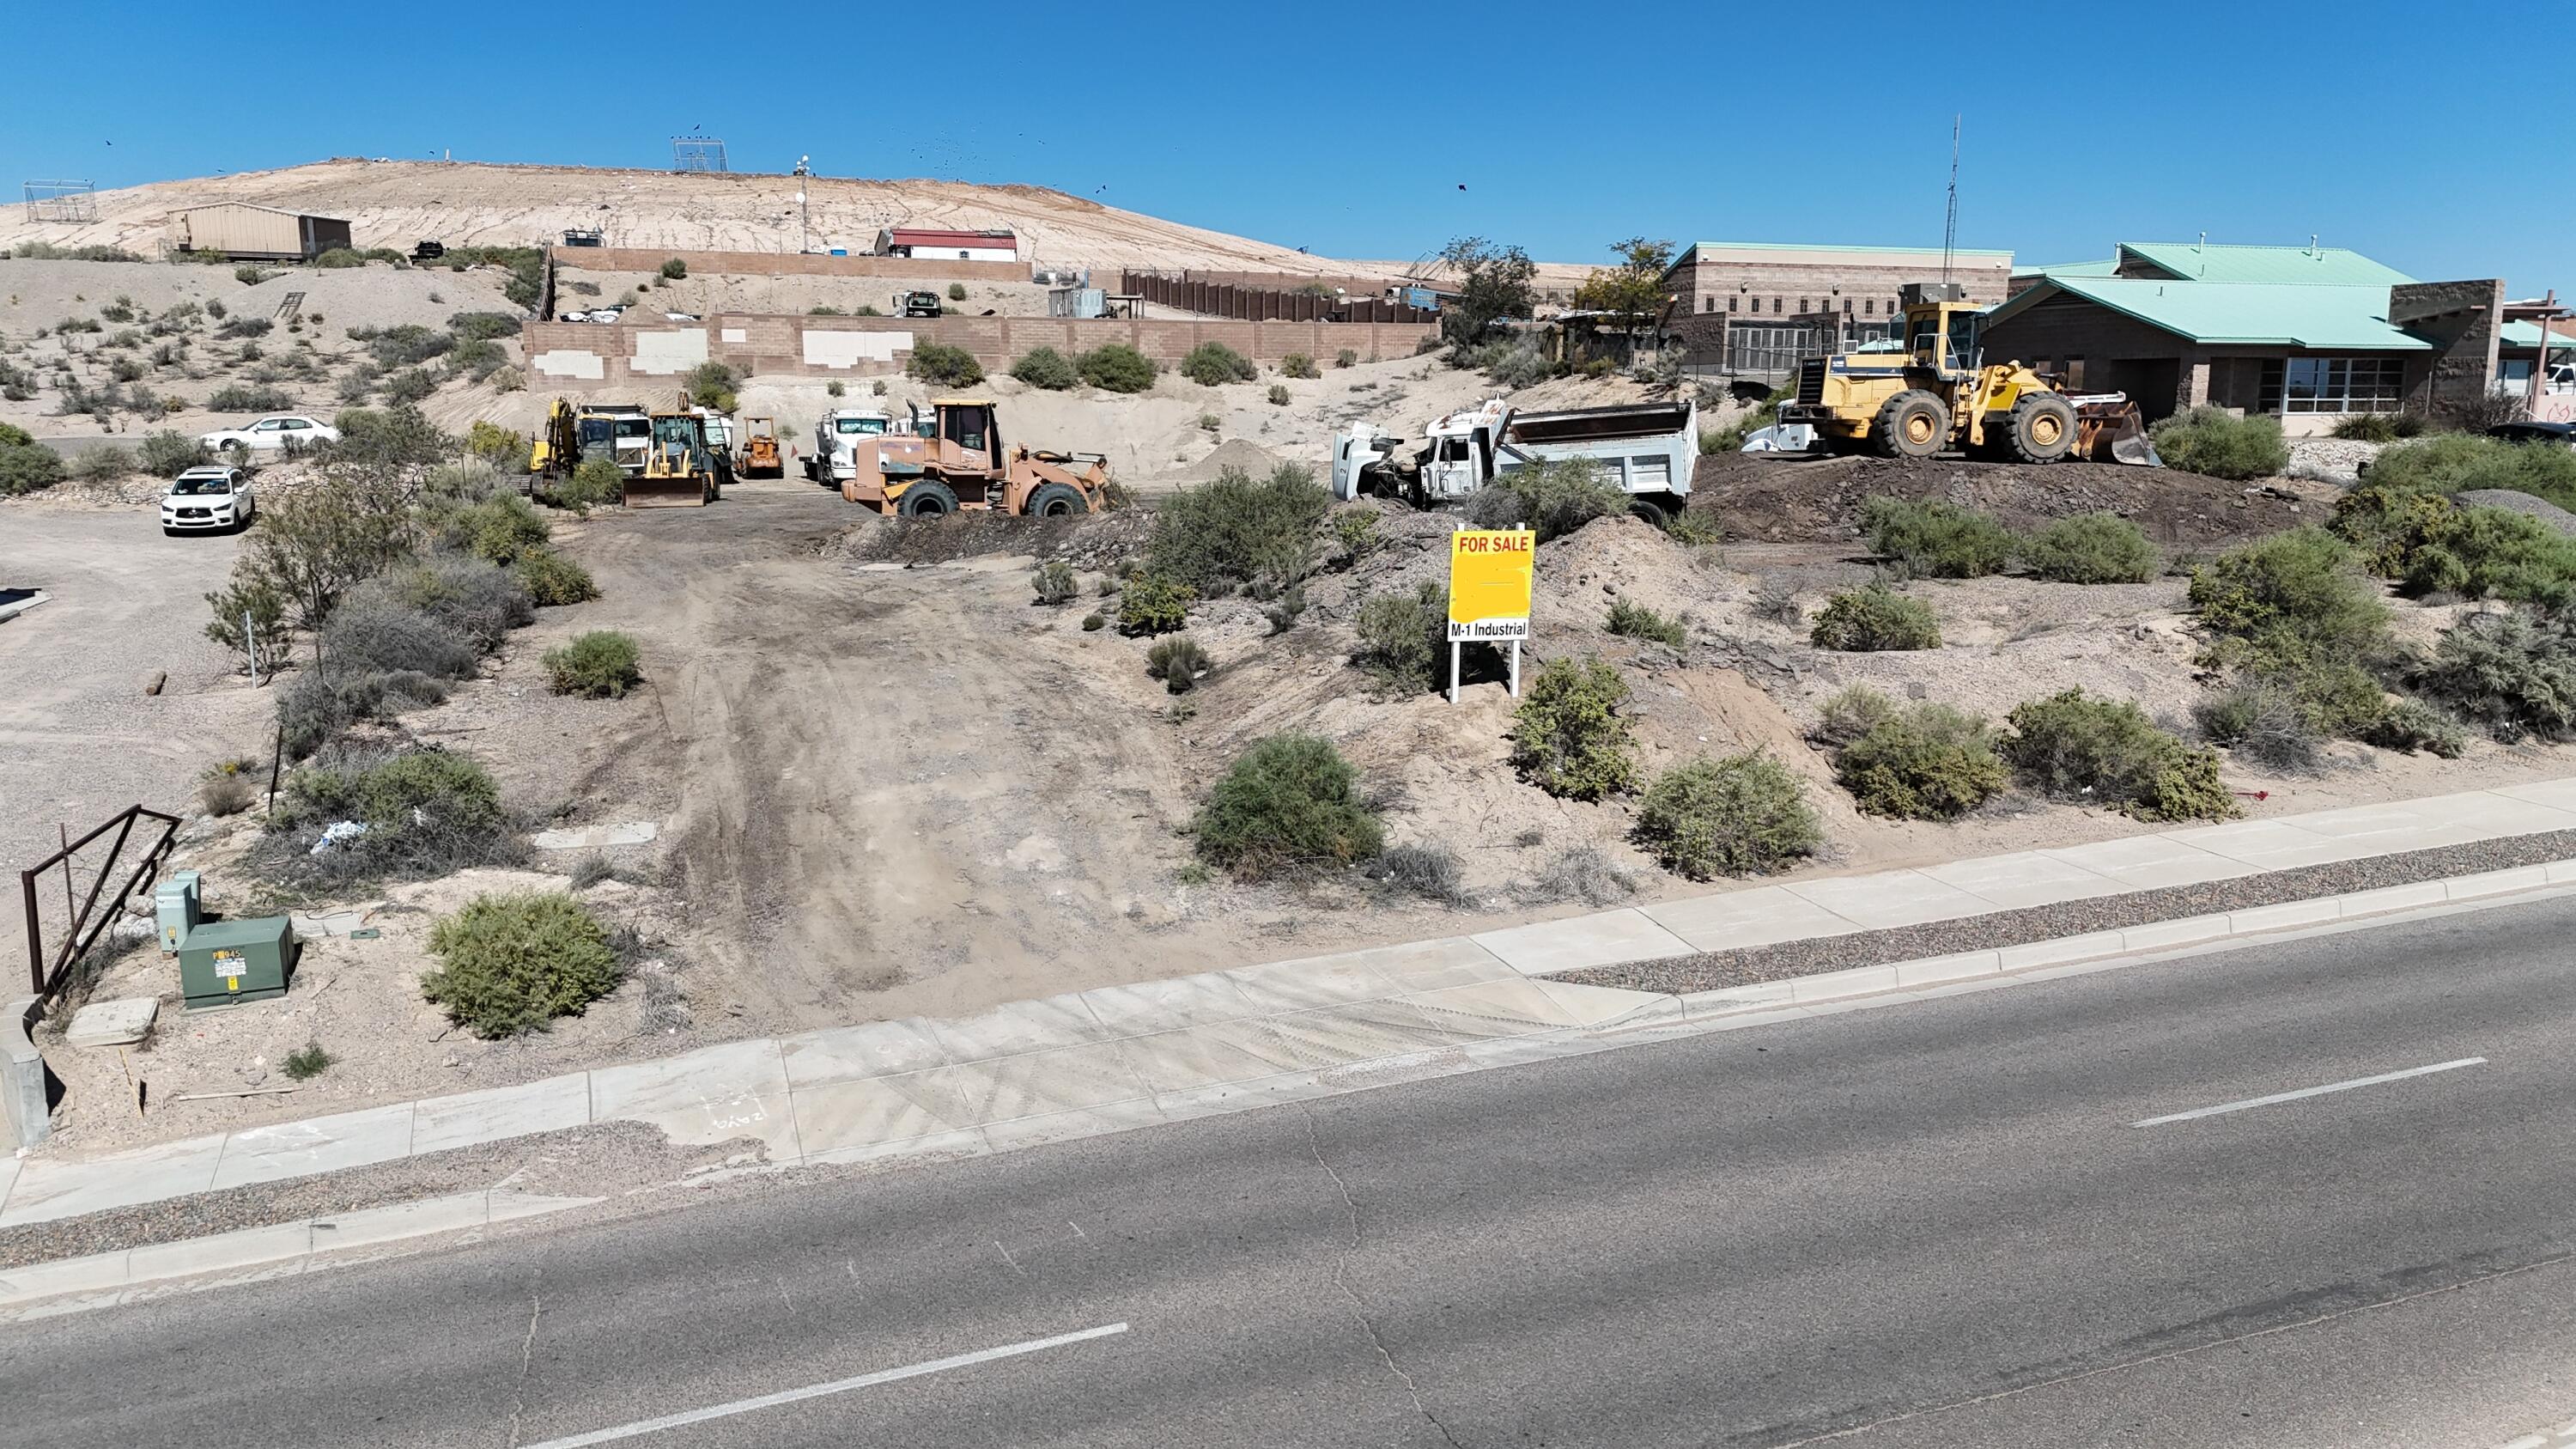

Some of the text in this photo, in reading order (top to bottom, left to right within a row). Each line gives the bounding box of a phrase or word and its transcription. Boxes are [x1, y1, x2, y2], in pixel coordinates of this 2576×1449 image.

[1460, 537, 1528, 551] FOR SALE
[1451, 622, 1526, 636] M-1 Industrial
